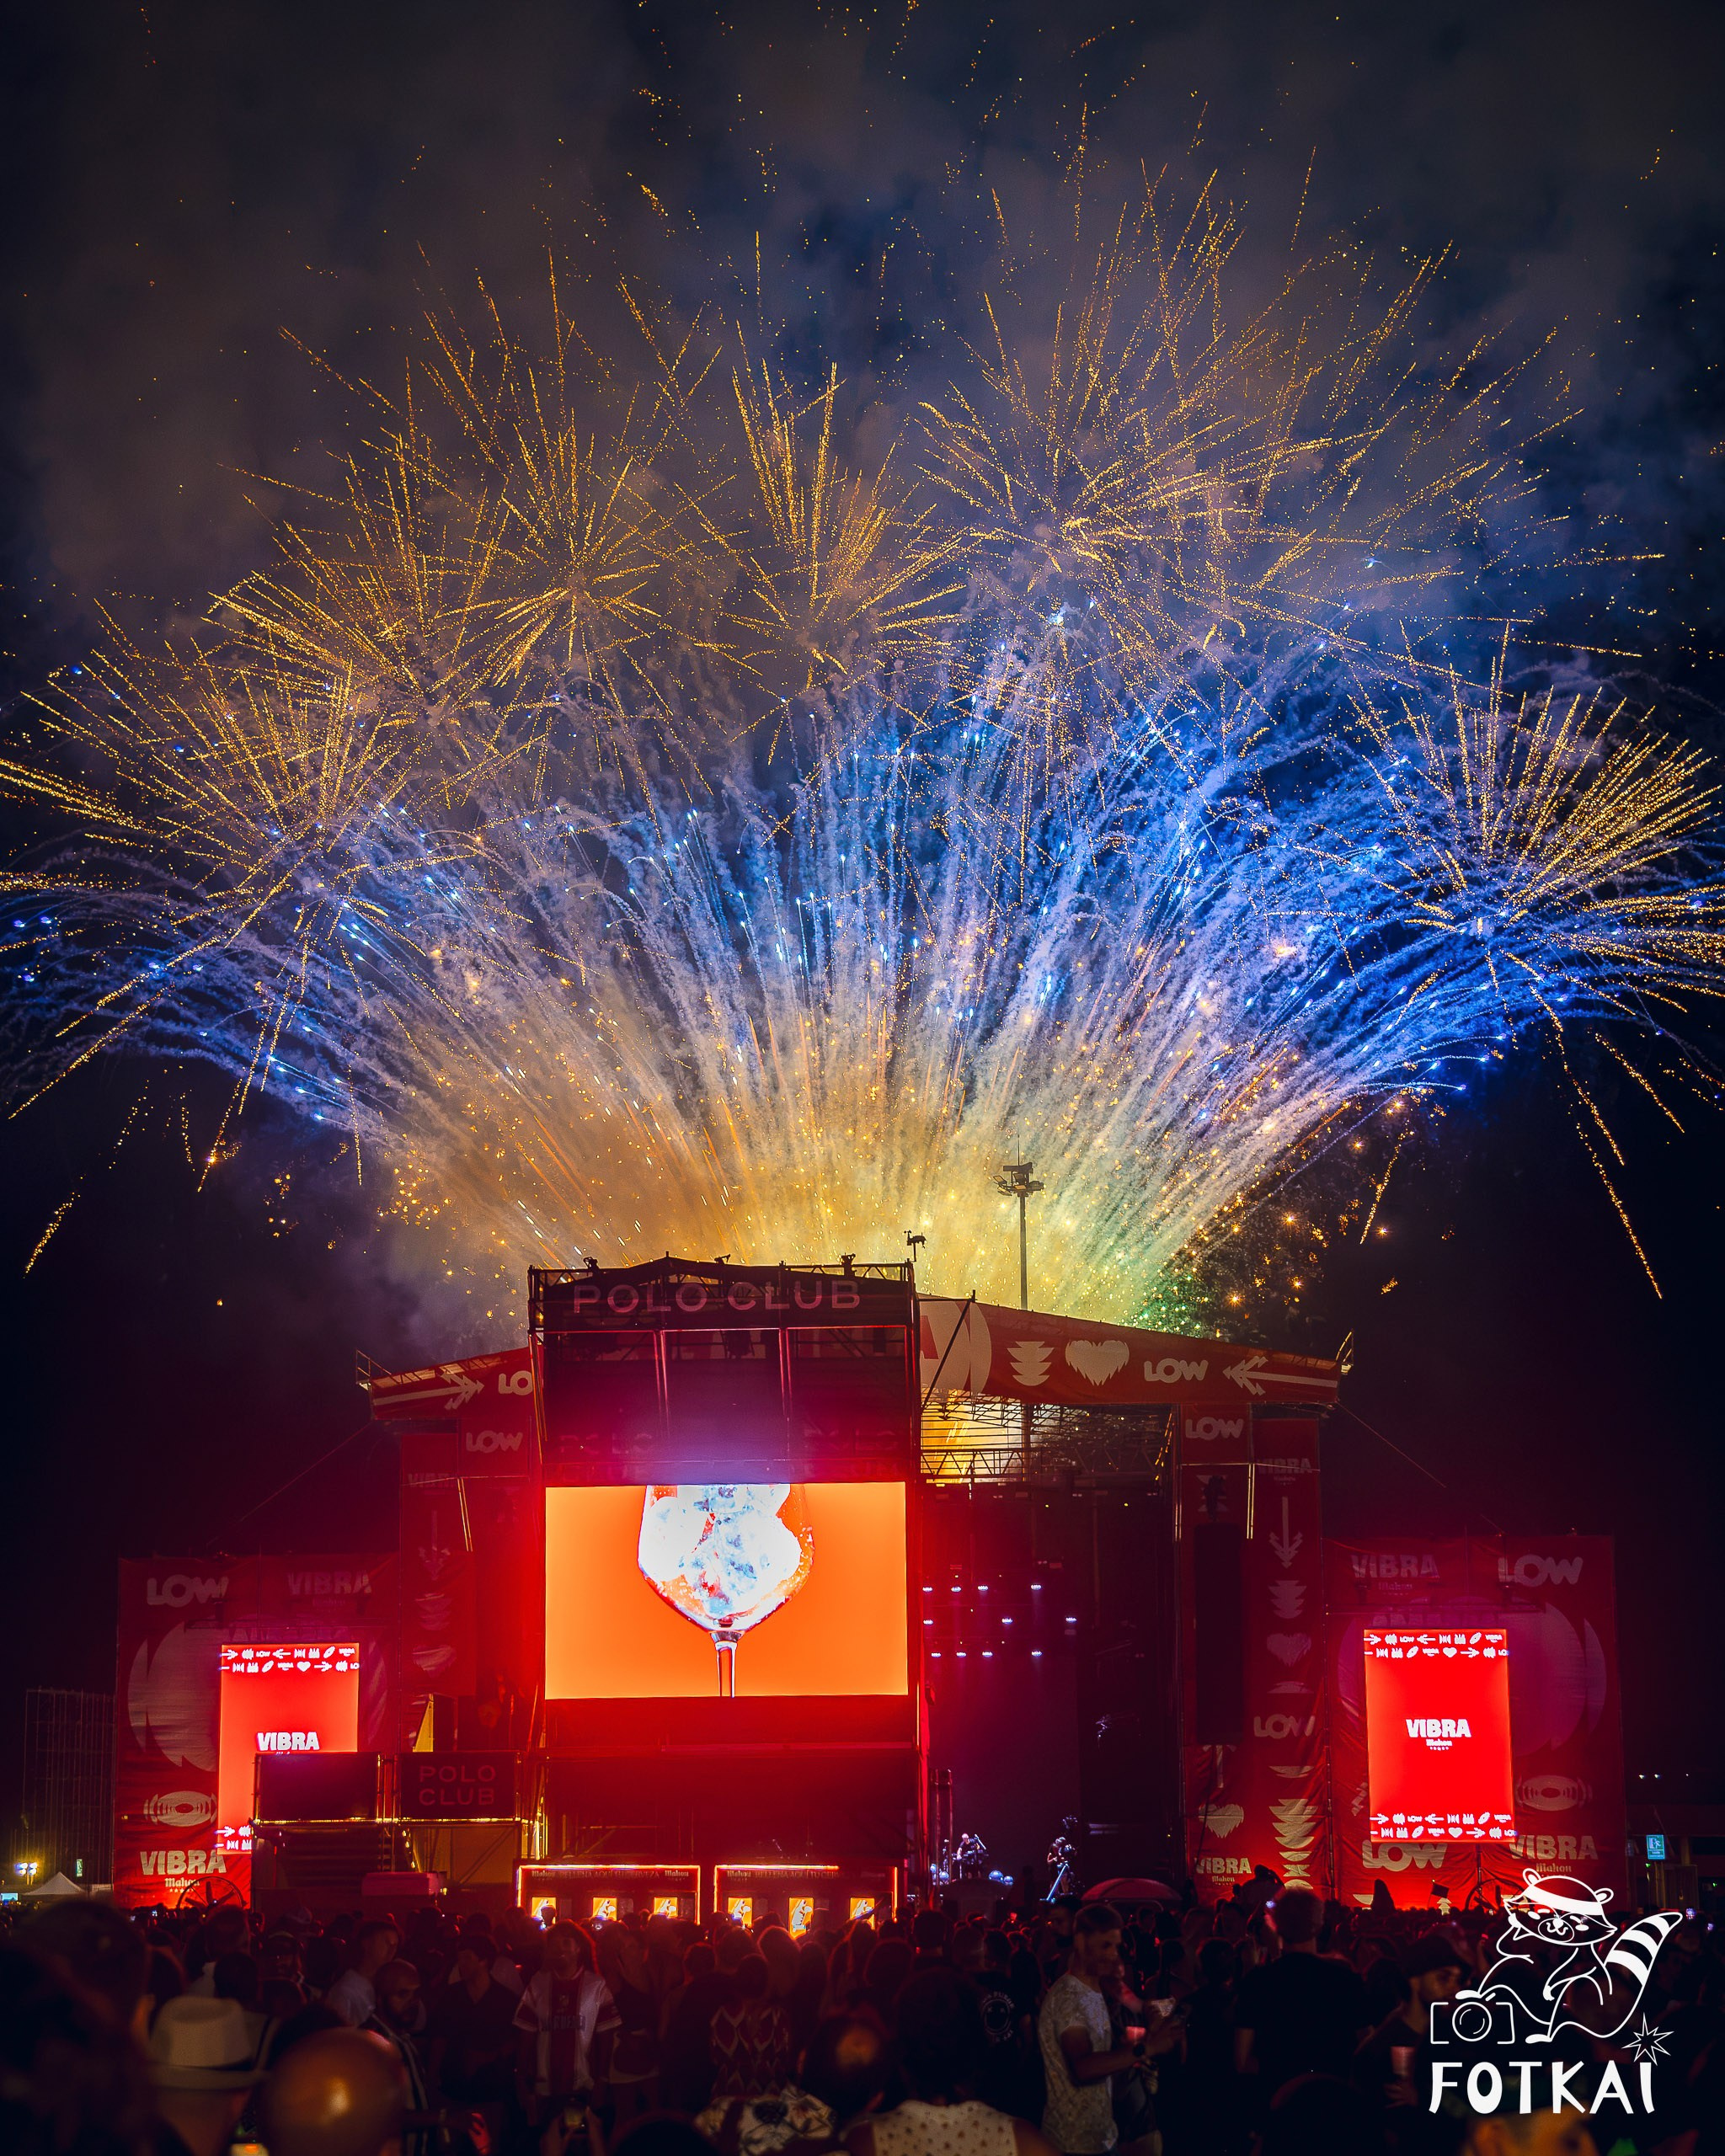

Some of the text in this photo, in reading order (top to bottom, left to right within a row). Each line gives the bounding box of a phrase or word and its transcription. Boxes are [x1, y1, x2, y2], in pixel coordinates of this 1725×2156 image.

[574, 1281, 861, 1313] POLO CLUB
[499, 1370, 534, 1396] LO
[1144, 1358, 1209, 1383] LOW
[1185, 1417, 1245, 1441] LOW
[466, 1430, 523, 1454] LOW
[1350, 1554, 1440, 1579] VIBRA
[1498, 1553, 1583, 1588] LOW
[147, 1574, 229, 1608] LOW
[287, 1570, 373, 1596] VIBRA
[1253, 1713, 1316, 1739] LOW
[1406, 1719, 1471, 1737] VIBRA
[257, 1732, 320, 1751] VIBRA
[419, 1765, 496, 1783] POLO
[419, 1787, 495, 1806] CLUB
[1362, 1839, 1448, 1871] LOW
[1509, 1835, 1599, 1860] VIBRA
[140, 1849, 227, 1876] VIBRA
[1194, 1857, 1252, 1874] VIBRA
